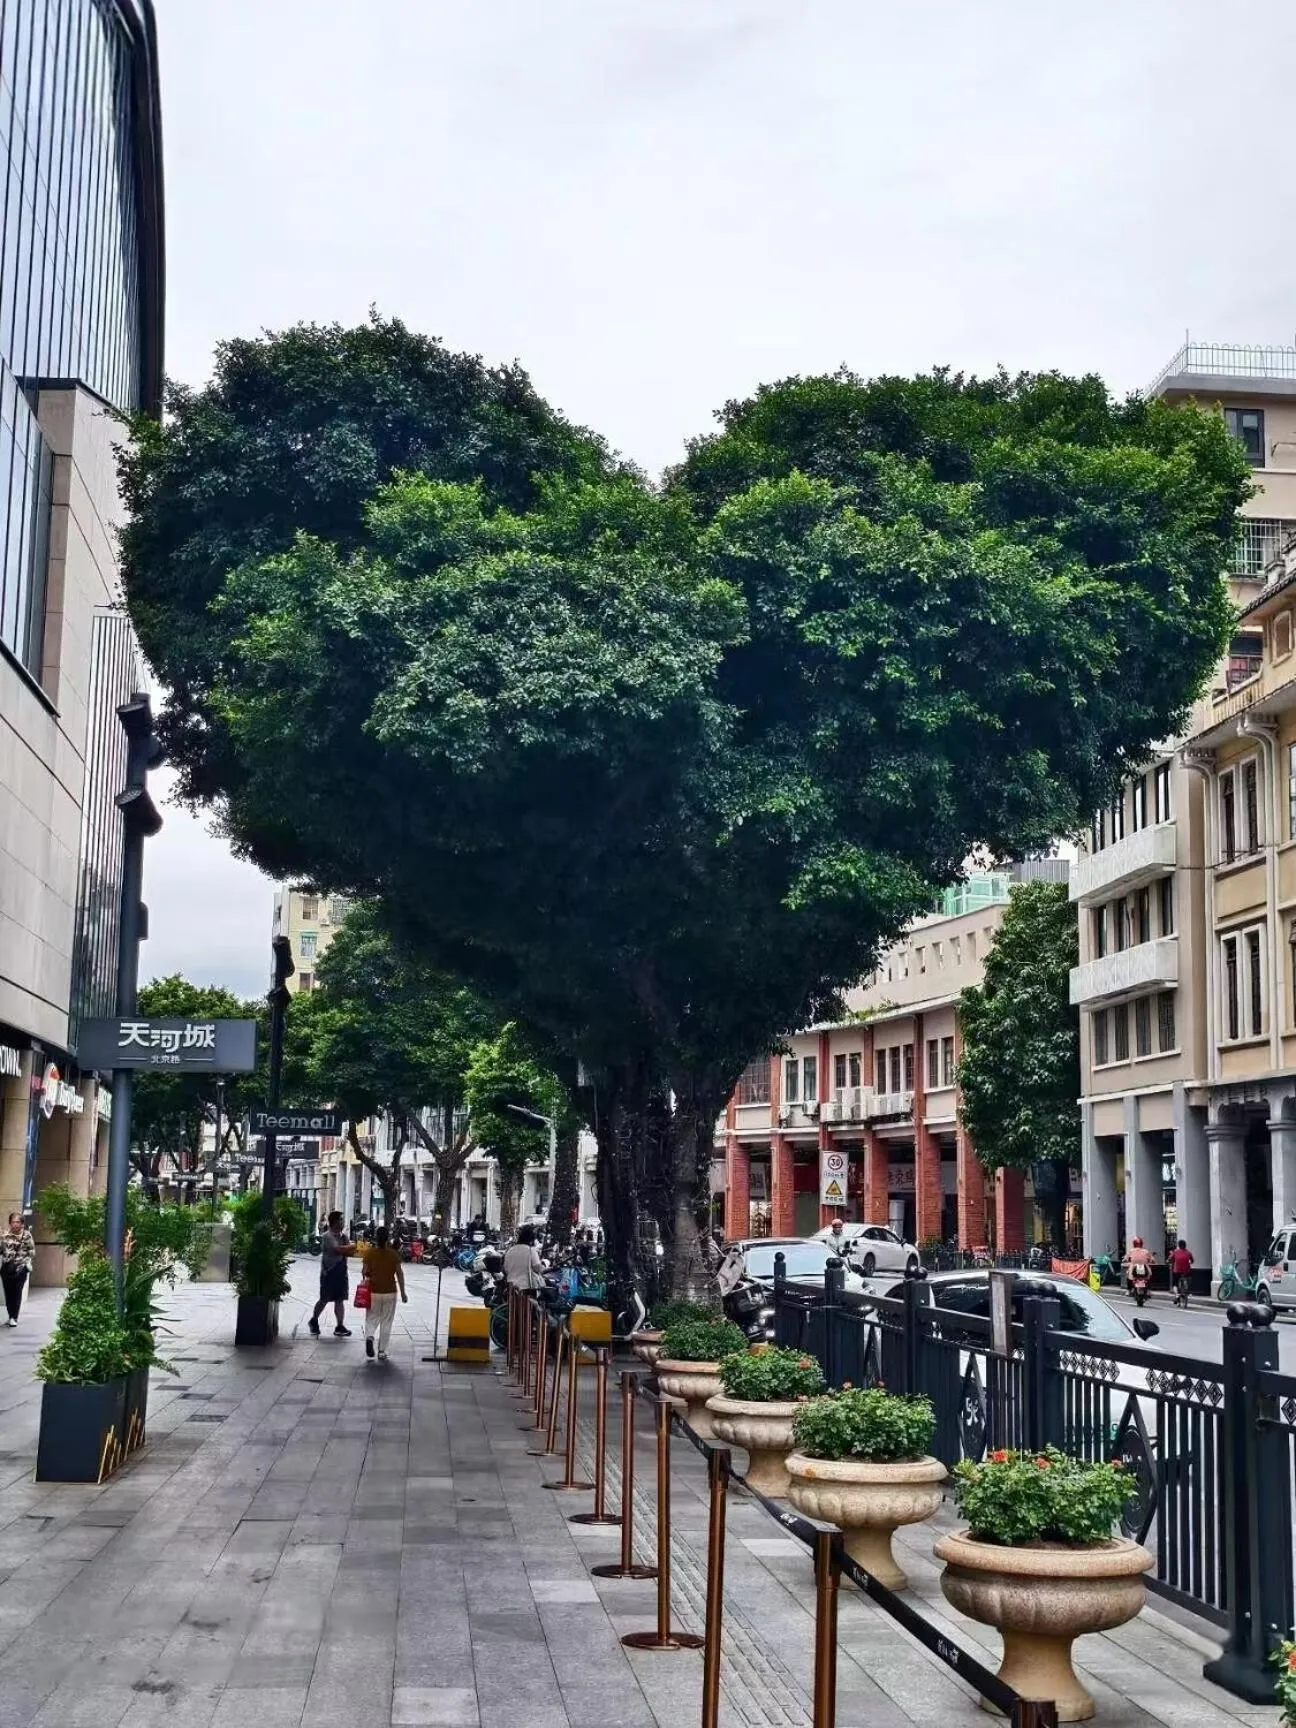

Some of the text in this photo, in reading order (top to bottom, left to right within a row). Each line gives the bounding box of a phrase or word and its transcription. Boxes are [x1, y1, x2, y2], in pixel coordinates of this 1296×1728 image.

[118, 1022, 215, 1053] 天河城
[257, 1112, 335, 1129] Teemall
